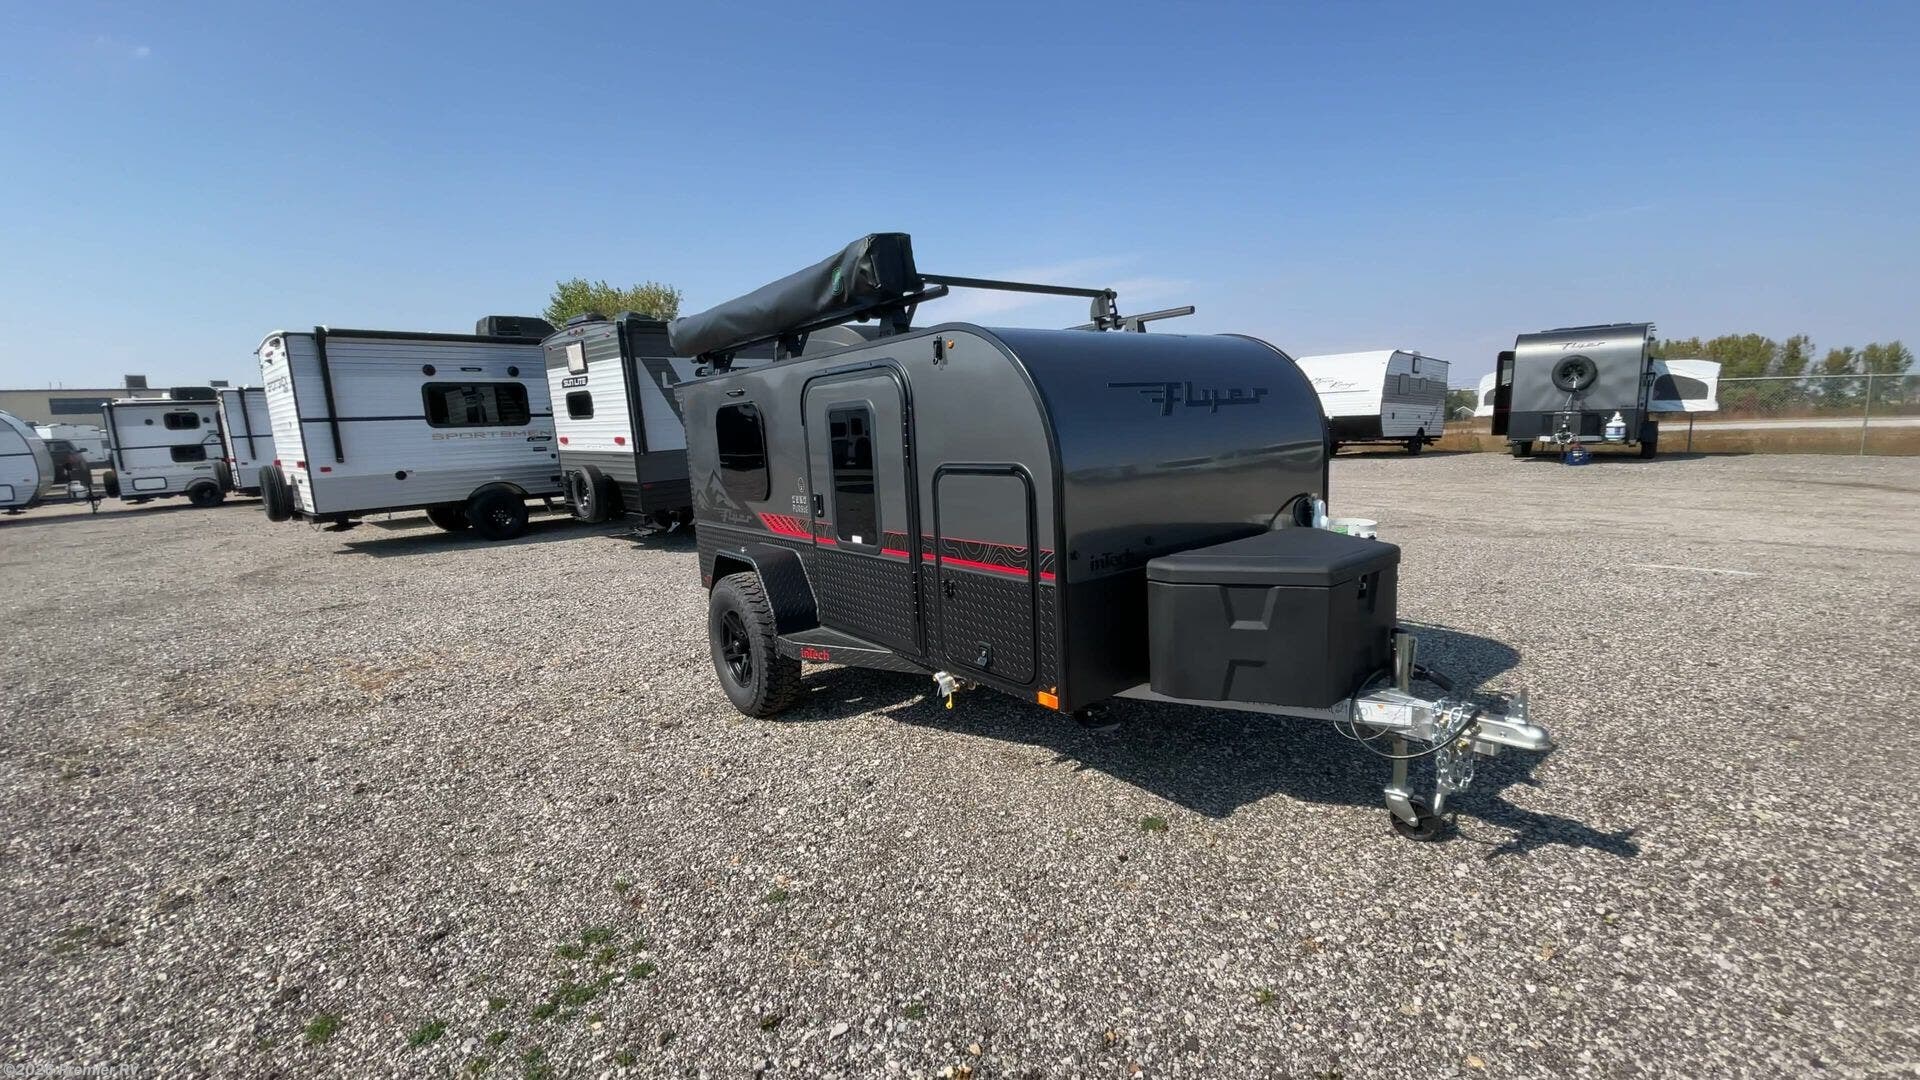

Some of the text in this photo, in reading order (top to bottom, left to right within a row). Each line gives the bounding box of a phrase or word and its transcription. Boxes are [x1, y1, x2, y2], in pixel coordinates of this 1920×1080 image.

[1107, 381, 1269, 416] Flyer
[431, 430, 552, 441] SPORTSMEN
[801, 646, 830, 661] inTech
